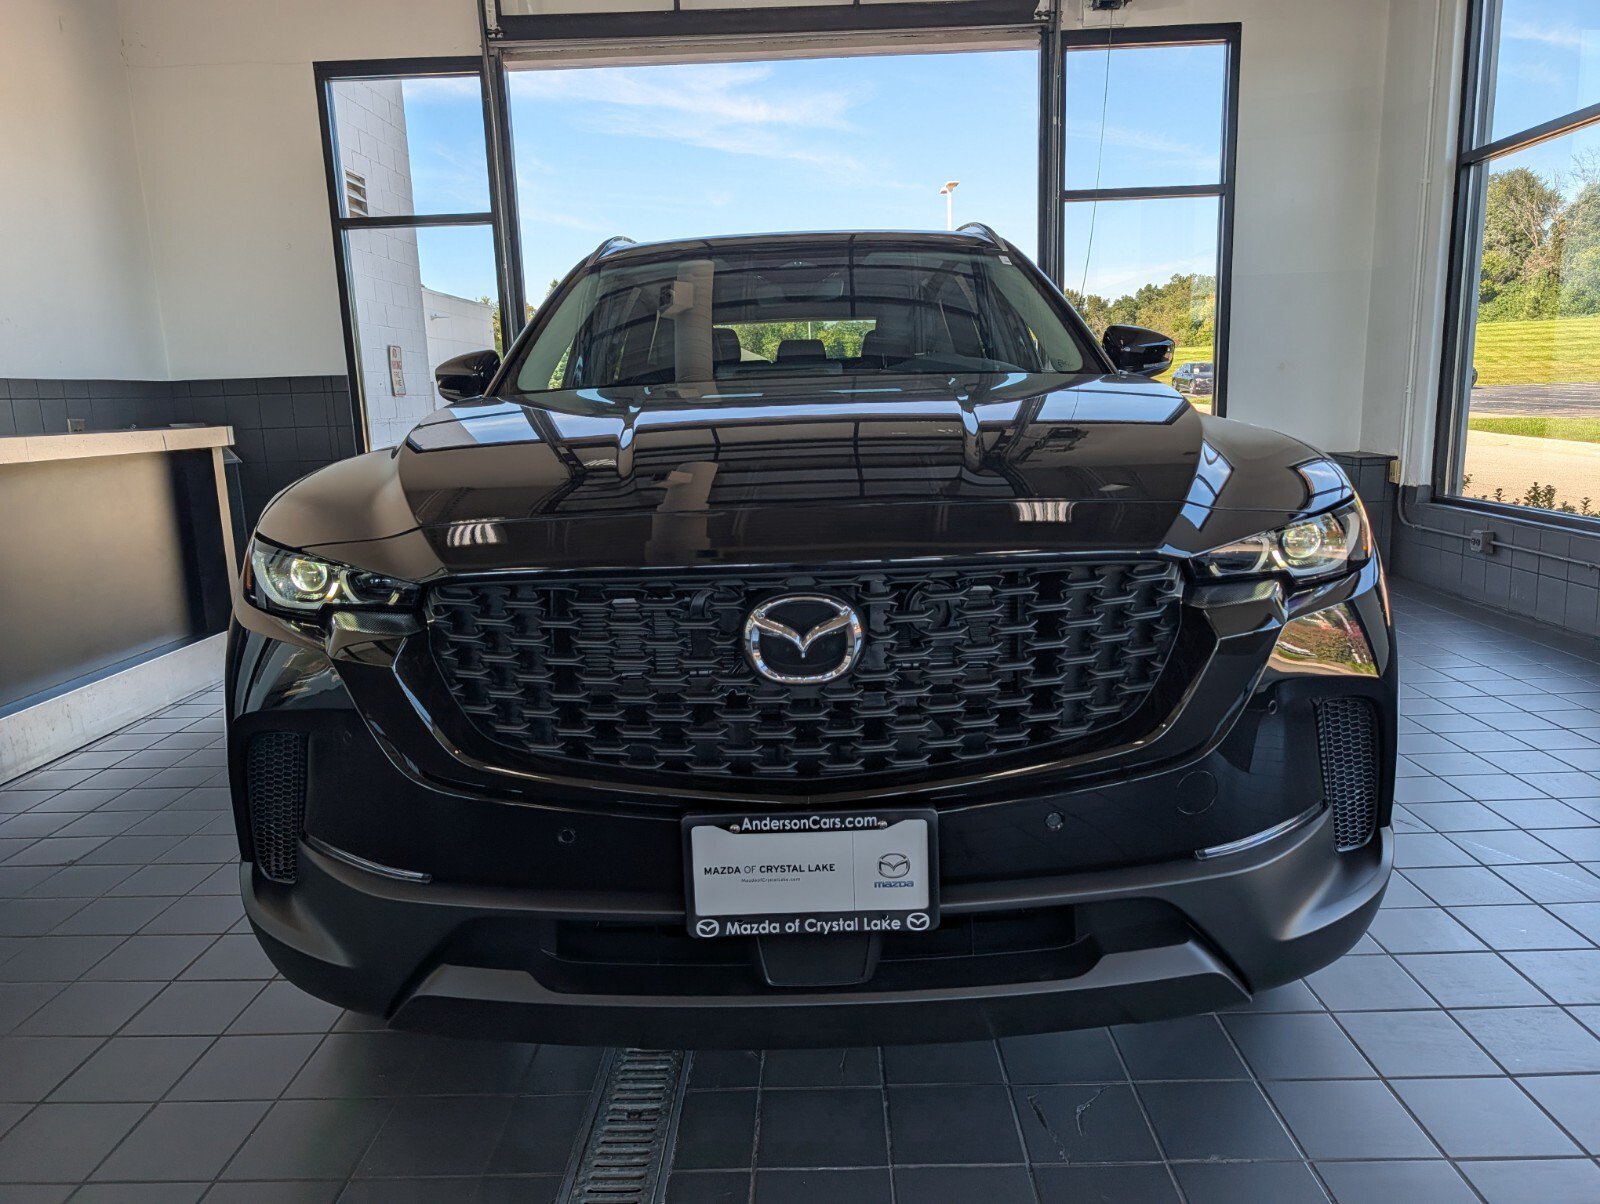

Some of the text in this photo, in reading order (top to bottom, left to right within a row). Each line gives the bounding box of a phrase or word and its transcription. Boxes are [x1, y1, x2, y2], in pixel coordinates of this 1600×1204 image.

[741, 815, 878, 832] AndersonCars.com
[704, 863, 836, 875] MAZDA OF CRYSTAL LAKE
[725, 916, 901, 935] Mazda of Crystal Lake
